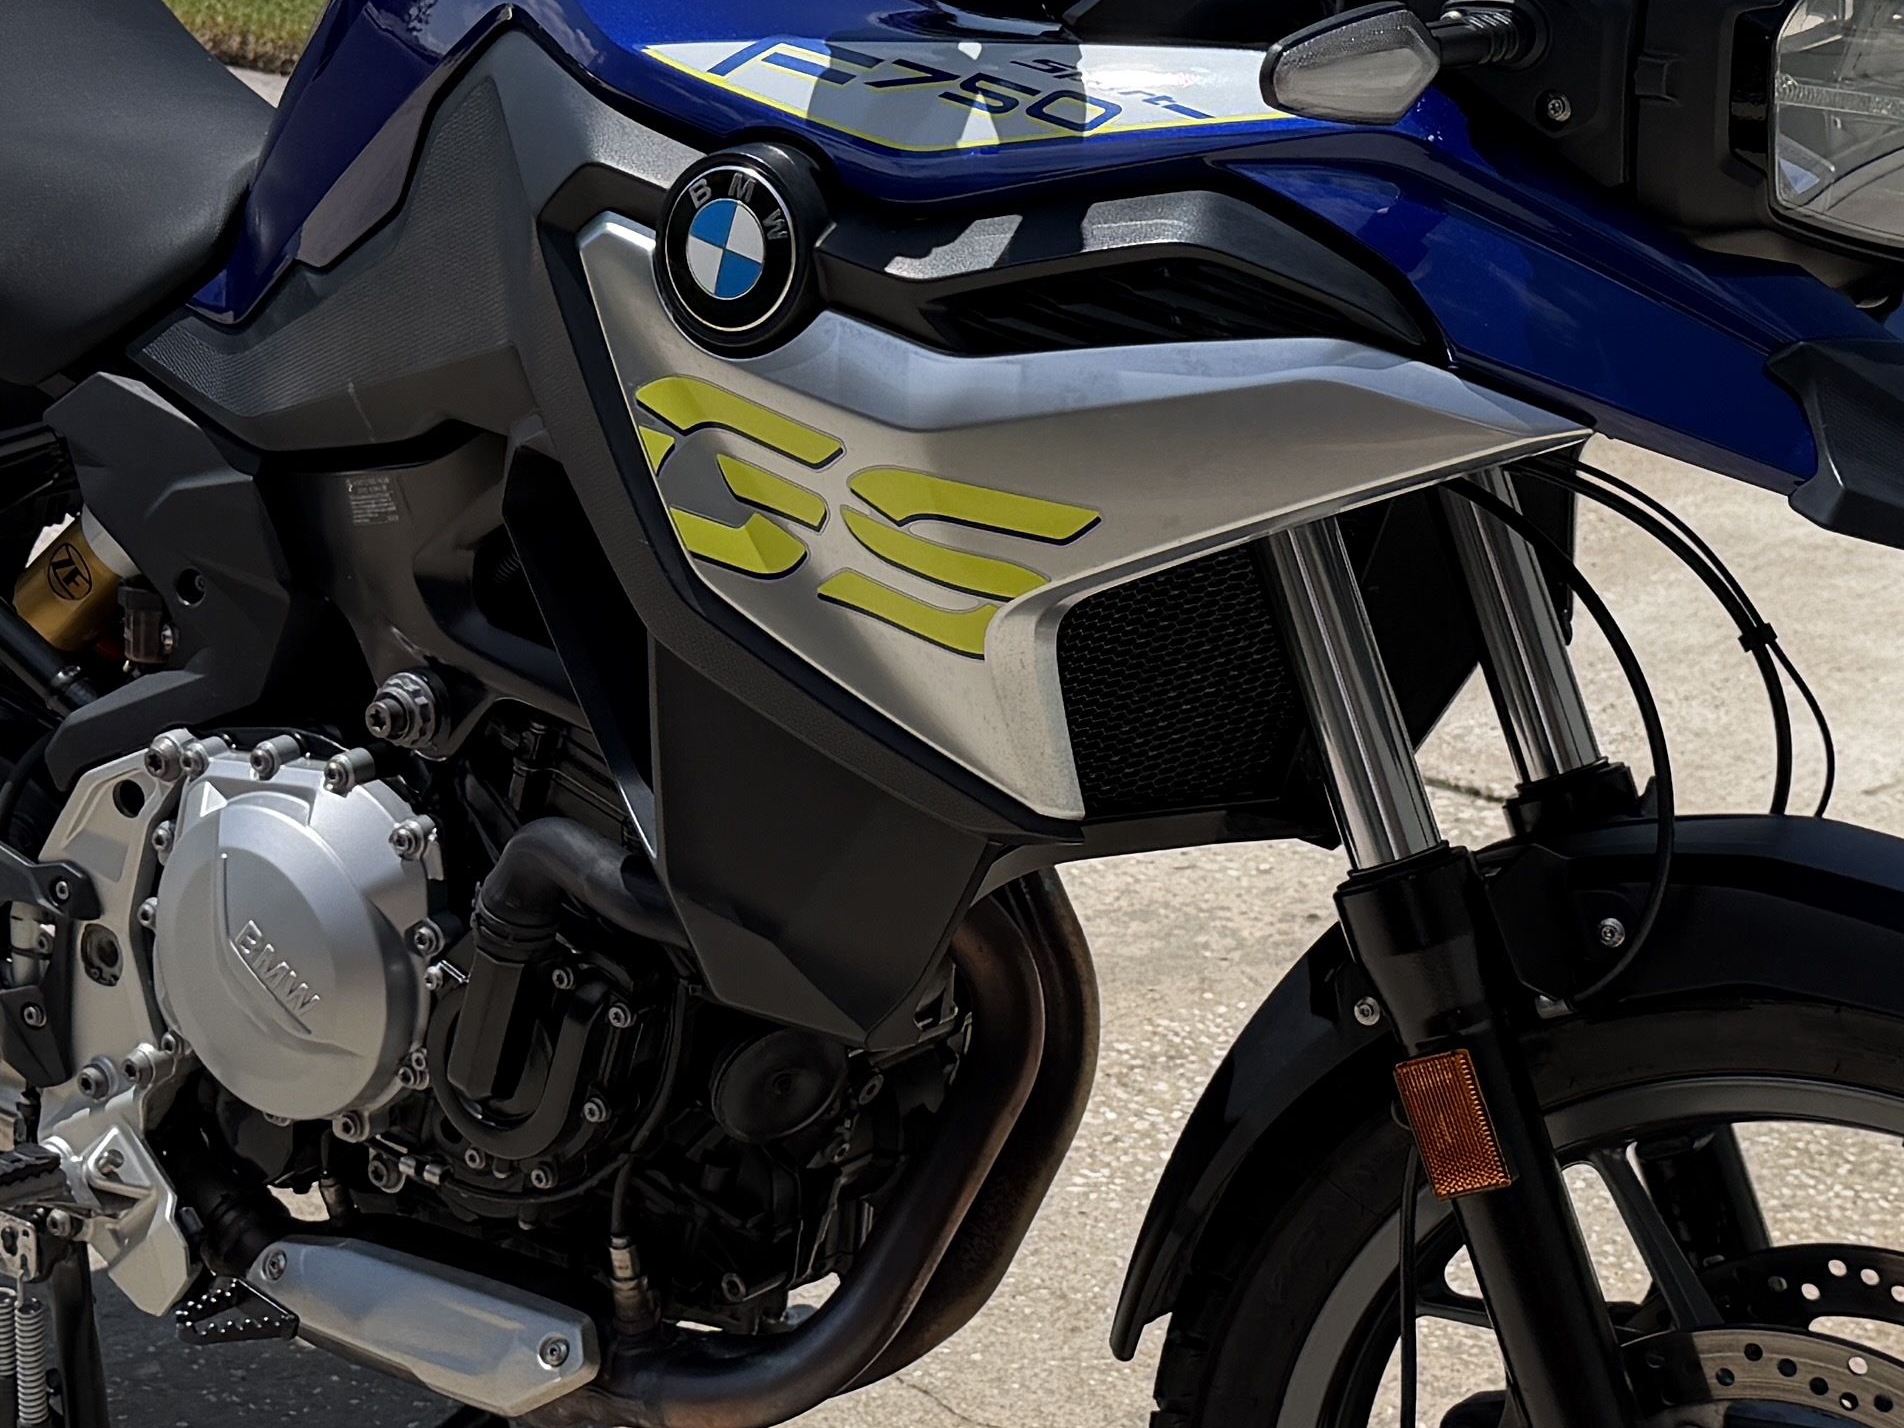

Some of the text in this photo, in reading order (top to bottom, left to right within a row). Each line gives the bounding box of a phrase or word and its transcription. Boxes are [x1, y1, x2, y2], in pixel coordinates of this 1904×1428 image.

[688, 172, 788, 241] BMW
[635, 374, 1101, 661] GS
[235, 919, 321, 1019] BMW
